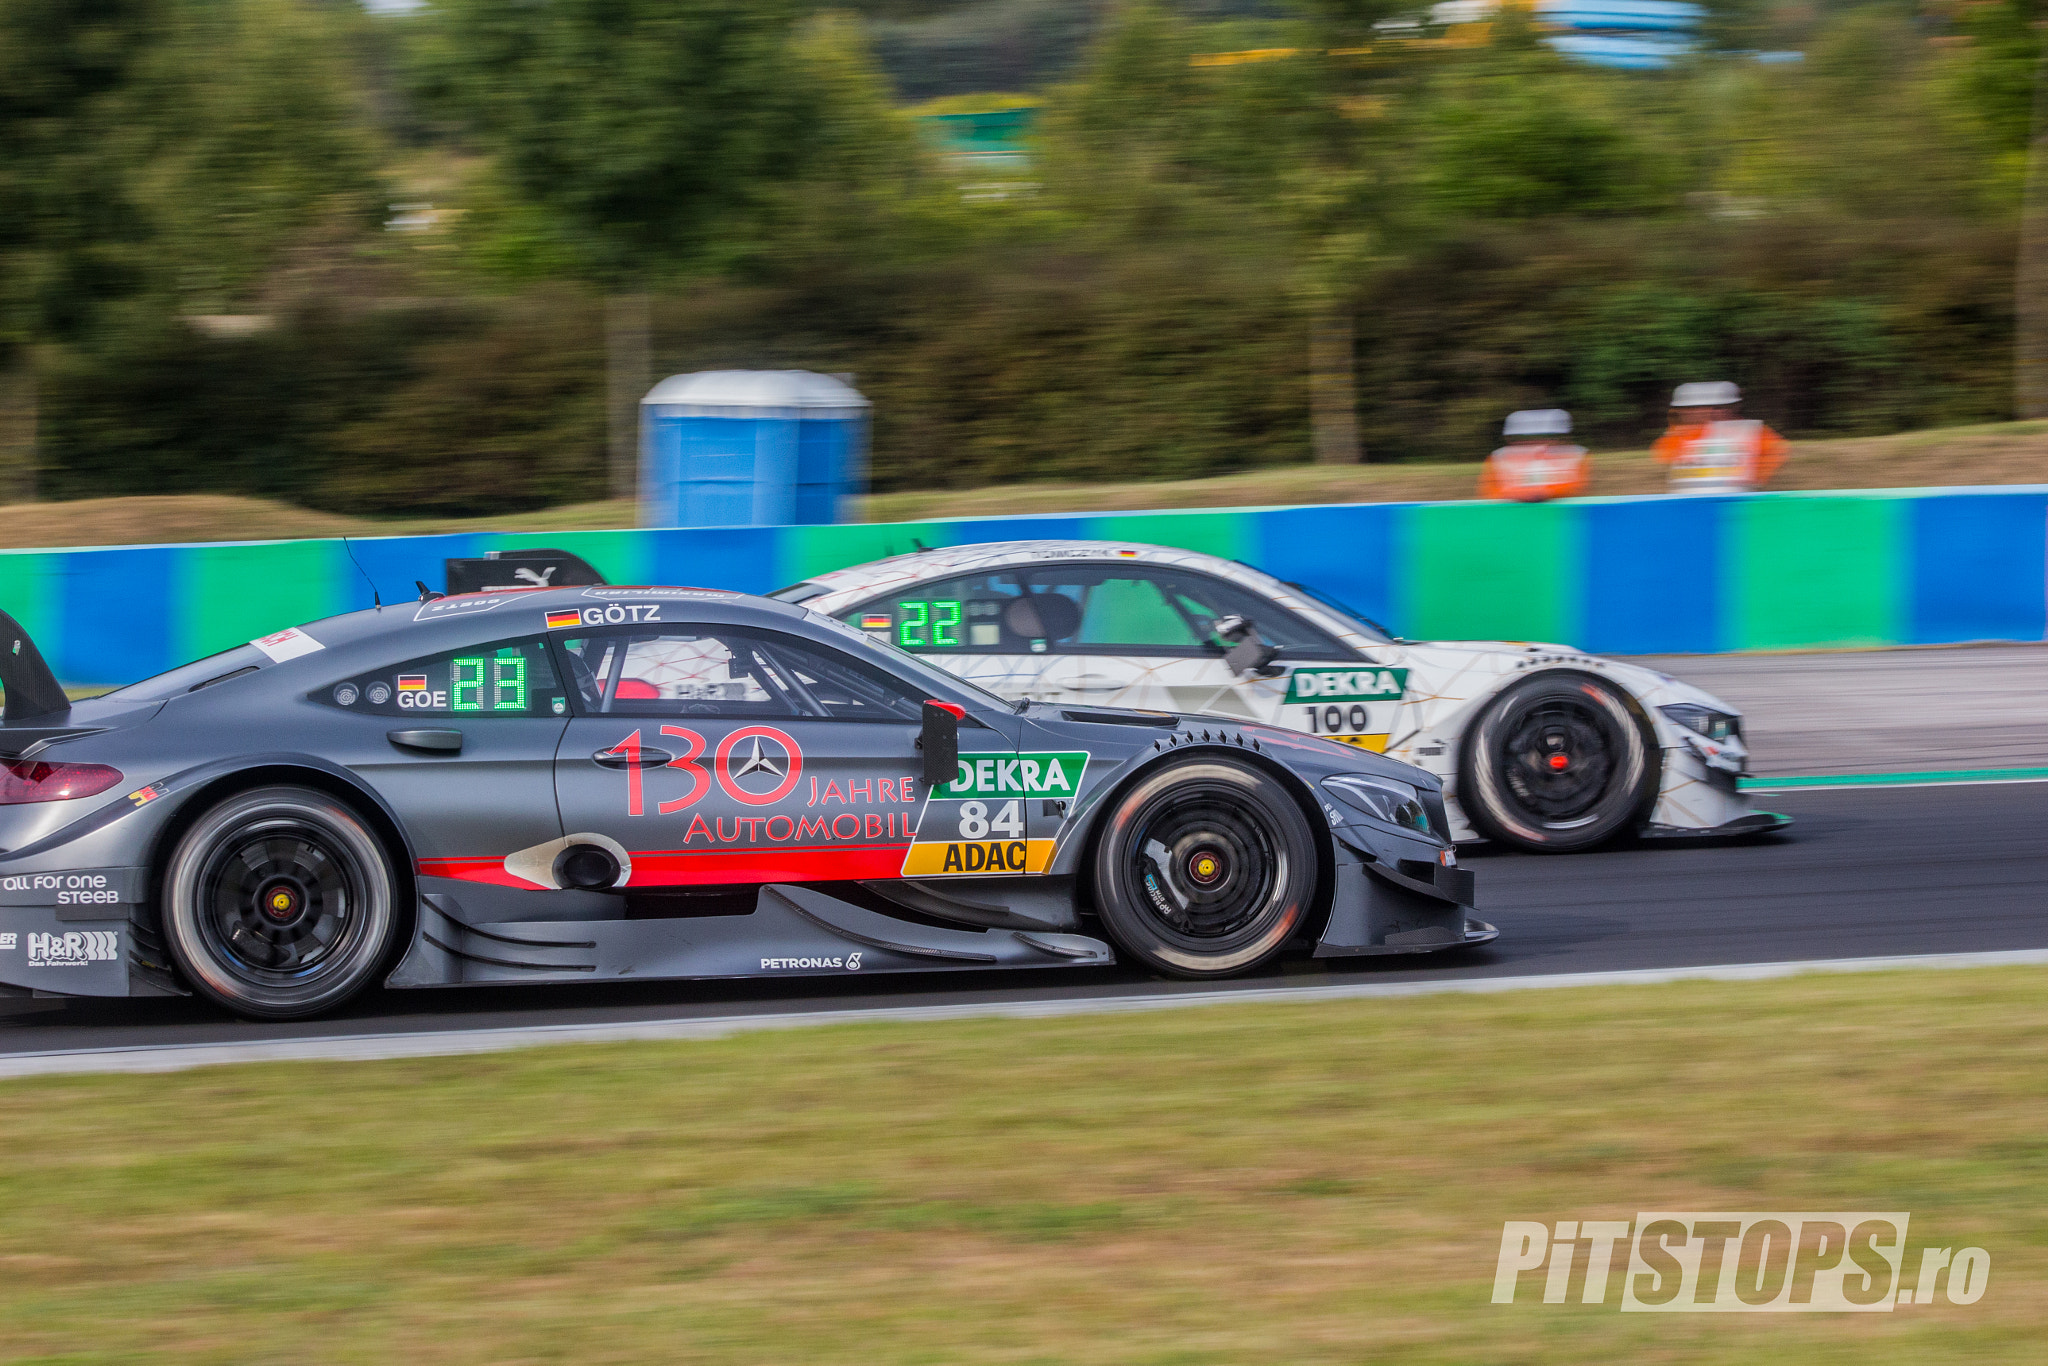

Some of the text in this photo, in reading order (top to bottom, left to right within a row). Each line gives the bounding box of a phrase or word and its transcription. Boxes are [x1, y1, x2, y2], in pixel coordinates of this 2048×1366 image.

[583, 603, 661, 625] GÖTZ
[899, 601, 962, 646] 22
[397, 690, 447, 708] GOE
[452, 657, 527, 711] 23
[1293, 670, 1403, 698] DEKRA
[1305, 704, 1367, 733] 100
[605, 725, 804, 816] 130
[949, 758, 1071, 793] DEKRA
[807, 776, 915, 807] JAHRE
[683, 812, 917, 844] AUTOMOBIL
[958, 800, 1024, 840] 84
[942, 841, 1027, 872] ADAC
[66, 875, 107, 889] one
[27, 932, 90, 961] H&R
[760, 957, 843, 969] PETRONAS
